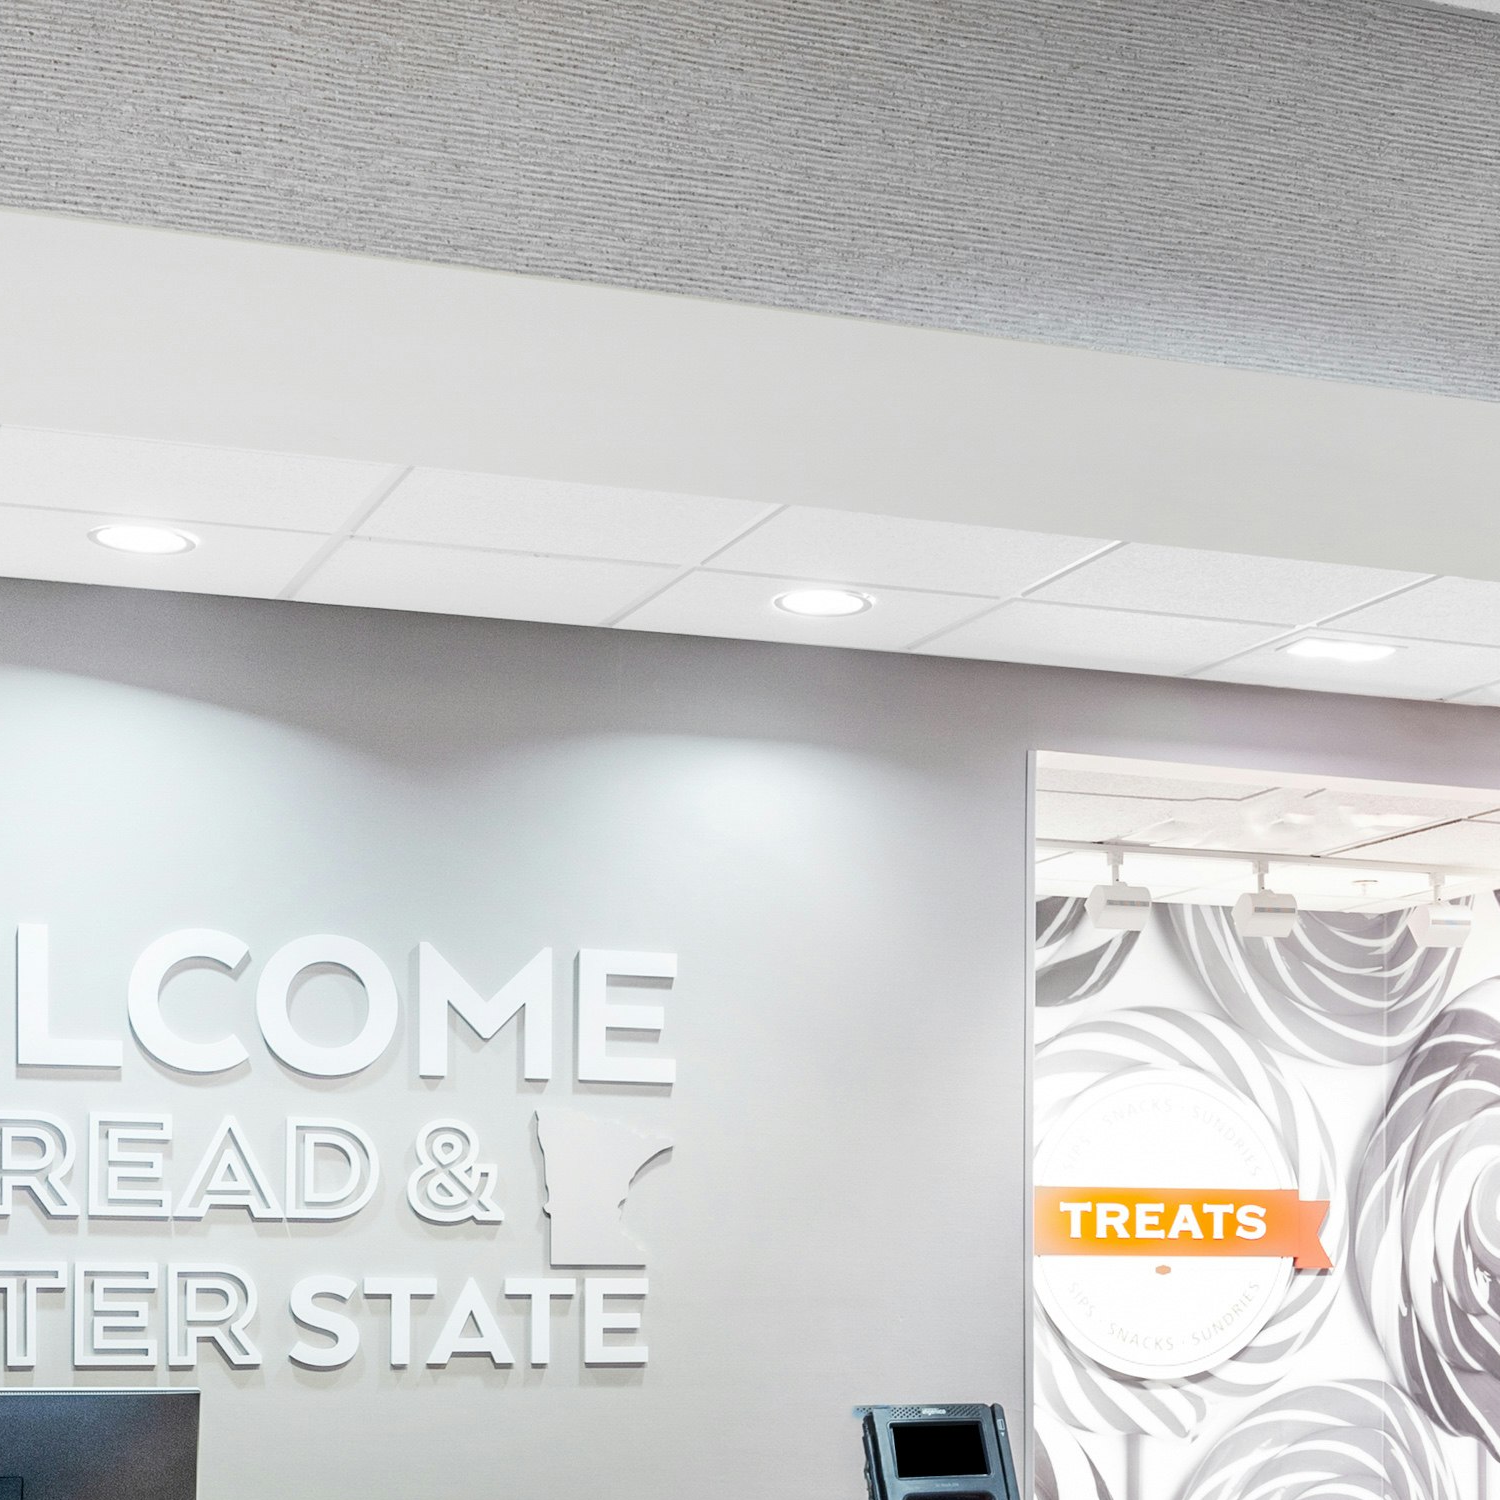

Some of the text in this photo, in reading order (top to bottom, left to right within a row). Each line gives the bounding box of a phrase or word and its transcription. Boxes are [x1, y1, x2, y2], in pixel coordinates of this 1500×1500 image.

[1101, 1097, 1174, 1128] SNACKS
[1192, 1105, 1264, 1177] SUNDRIES
[407, 1118, 503, 1222] &
[1059, 1202, 1267, 1240] TREATS
[289, 1277, 649, 1368] STATE
[1067, 1281, 1096, 1318] SIPS
[1192, 1280, 1260, 1346] SUNDRIES
[1108, 1321, 1175, 1351] SNACKS
